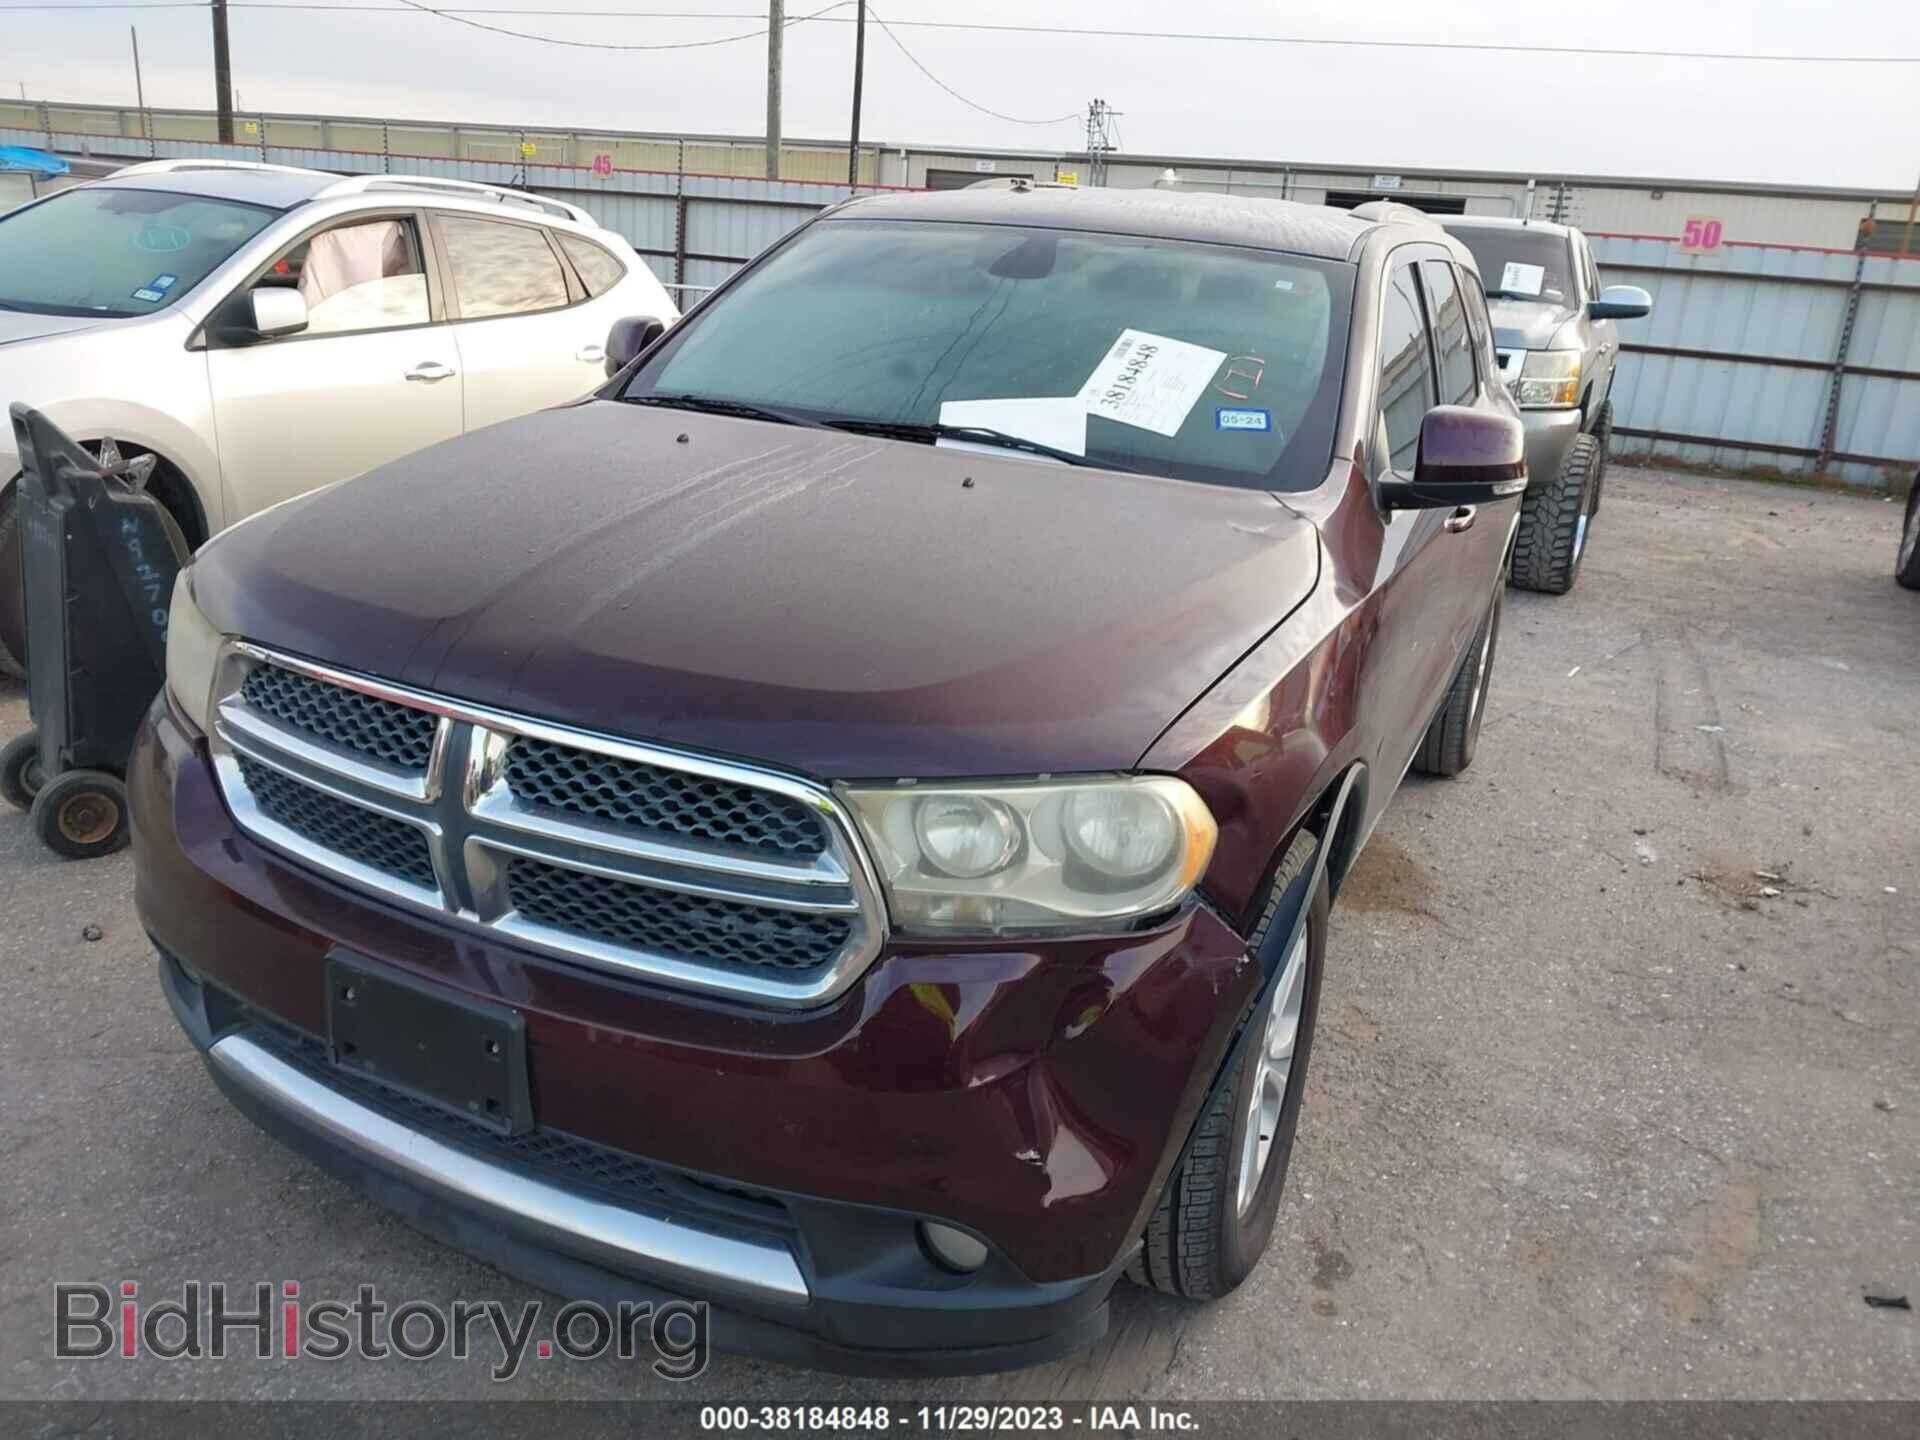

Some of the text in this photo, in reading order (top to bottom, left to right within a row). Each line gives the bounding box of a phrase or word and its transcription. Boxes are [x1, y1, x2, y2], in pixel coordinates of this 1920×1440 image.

[593, 154, 611, 175] 45
[1682, 219, 1722, 249] 50
[1100, 343, 1159, 409] 38184848
[1222, 415, 1262, 425] 05-24
